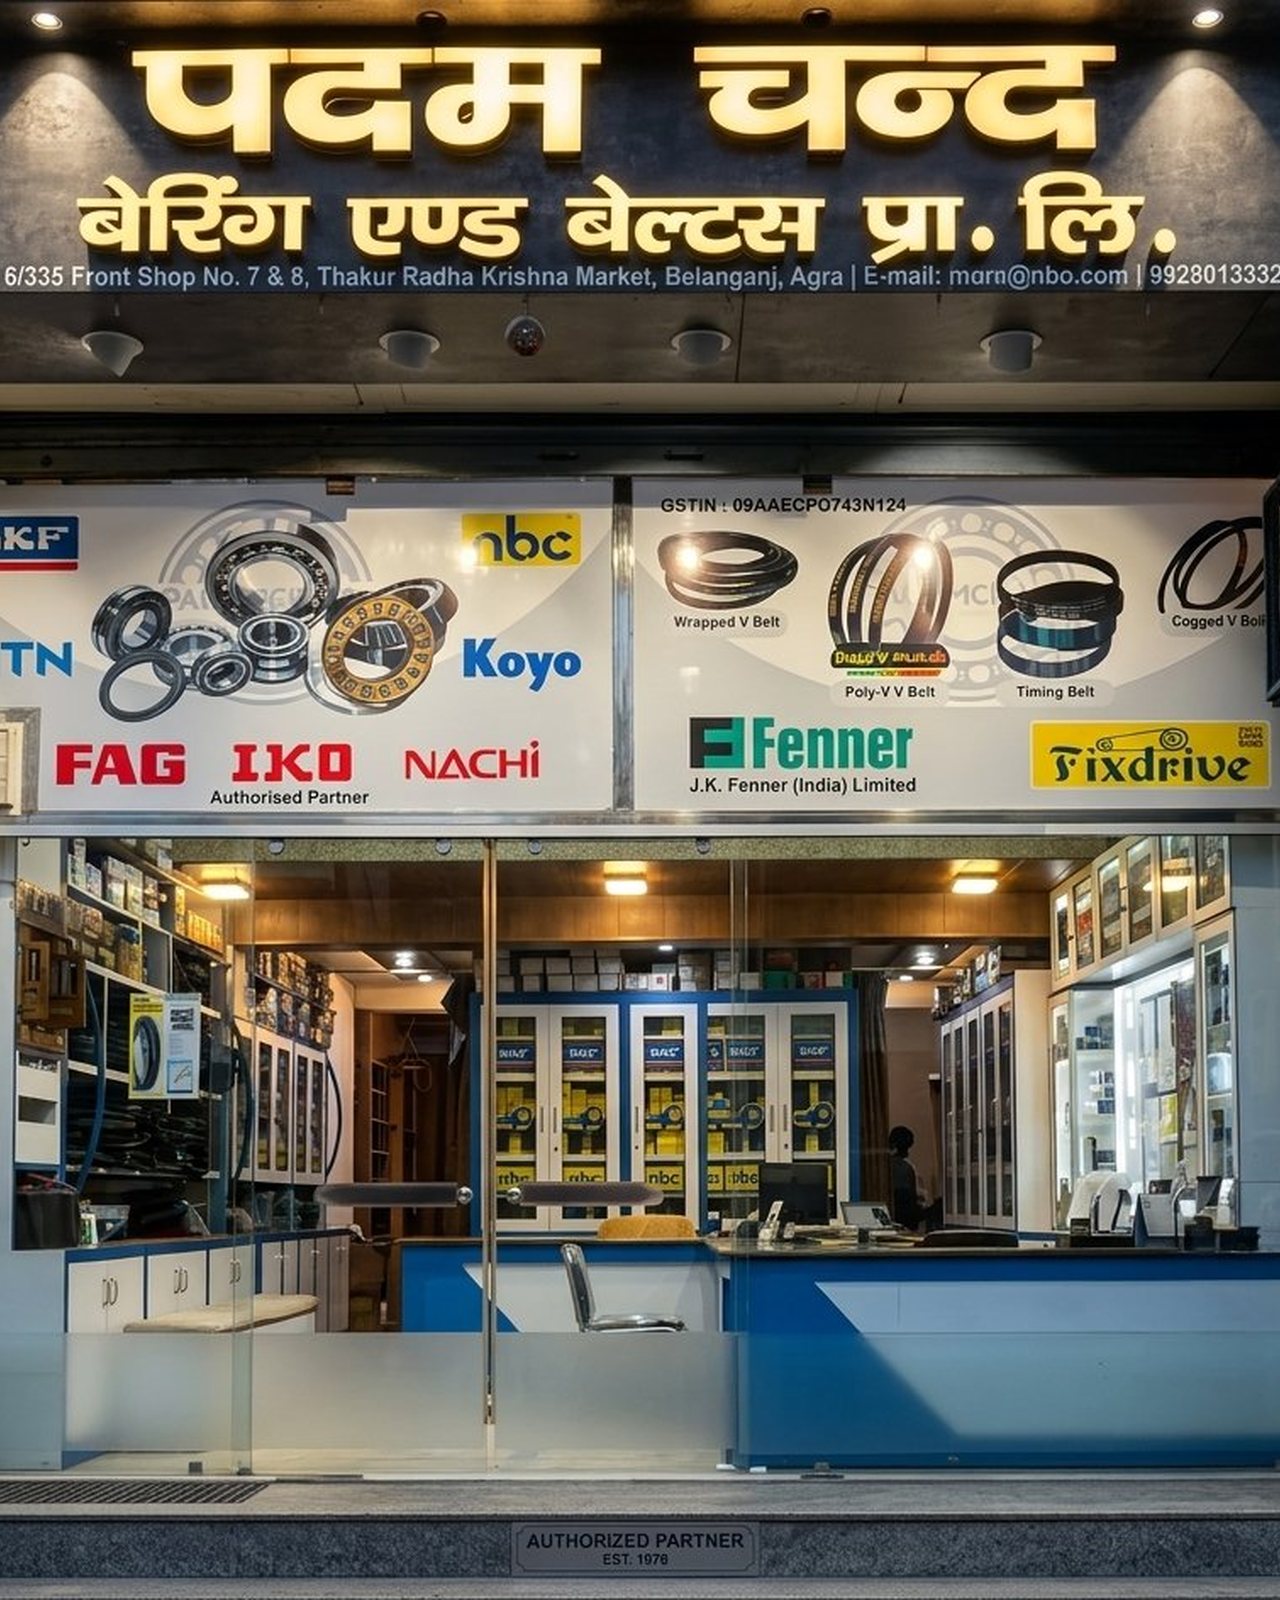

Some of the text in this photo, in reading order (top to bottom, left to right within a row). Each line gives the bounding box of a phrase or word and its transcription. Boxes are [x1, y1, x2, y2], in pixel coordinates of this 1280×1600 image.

[132, 45, 1116, 152] पदम चन्द
[77, 172, 311, 252] बेरिंग
[346, 198, 529, 258] एण्ड
[565, 174, 826, 254] बेल्टस
[4, 266, 64, 286] 6/335
[71, 266, 130, 286] Front
[137, 266, 196, 291] Shop
[203, 266, 240, 286] No.
[247, 266, 260, 286] 7
[290, 266, 310, 289] 8,
[317, 266, 396, 286] Thakur
[403, 266, 473, 286] Radha
[481, 265, 568, 286] Krishna
[576, 266, 657, 289] Market,
[665, 266, 783, 291] Belanganj,
[790, 266, 844, 291] Agra
[864, 265, 941, 285] E-mail:
[1150, 264, 1280, 285] 9928013332
[661, 498, 717, 513] GSTIN
[0, 526, 70, 550] KF
[473, 514, 573, 561] nbc
[673, 615, 781, 631] Wrapped V Belt
[1172, 614, 1224, 630] Cogged
[1227, 615, 1238, 627] V
[463, 638, 582, 691] Koyo
[846, 685, 890, 701] Poly-V
[894, 686, 904, 698] V
[1016, 685, 1095, 701] Timing Belt
[752, 717, 913, 769] Fenner
[56, 744, 186, 785] FAG
[232, 744, 352, 781] IKO
[1050, 746, 1251, 782] Fixdrive
[210, 790, 369, 804] Authorised Partner
[690, 777, 917, 796] J.K. Fenner (India) Limited
[527, 1533, 744, 1549] AUTHORIZED PARTNER
[603, 1554, 633, 1565] EST.
